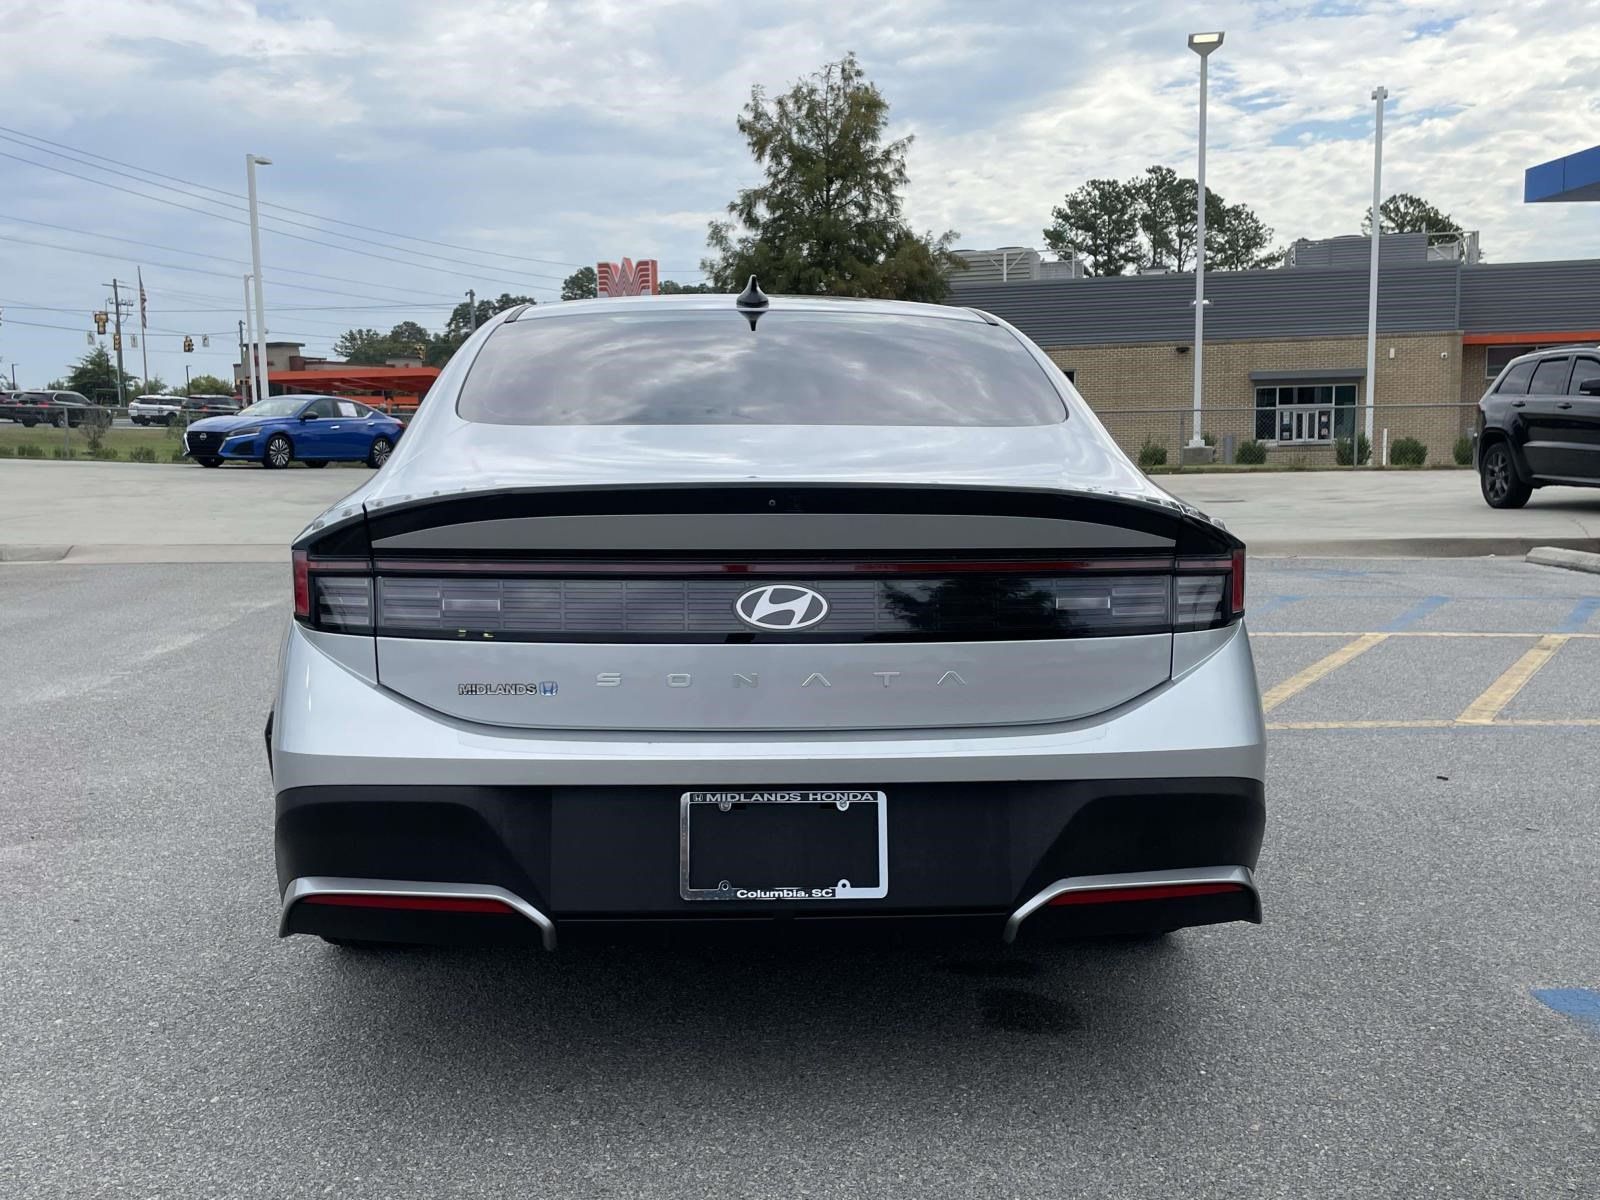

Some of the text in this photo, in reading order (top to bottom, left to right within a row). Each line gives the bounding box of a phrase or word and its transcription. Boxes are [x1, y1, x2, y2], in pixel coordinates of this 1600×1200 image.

[596, 670, 967, 688] SONATA
[458, 683, 537, 696] MIDLANDS
[706, 792, 801, 802] MIDLANDS
[809, 792, 874, 802] HONDA
[811, 888, 833, 898] SC
